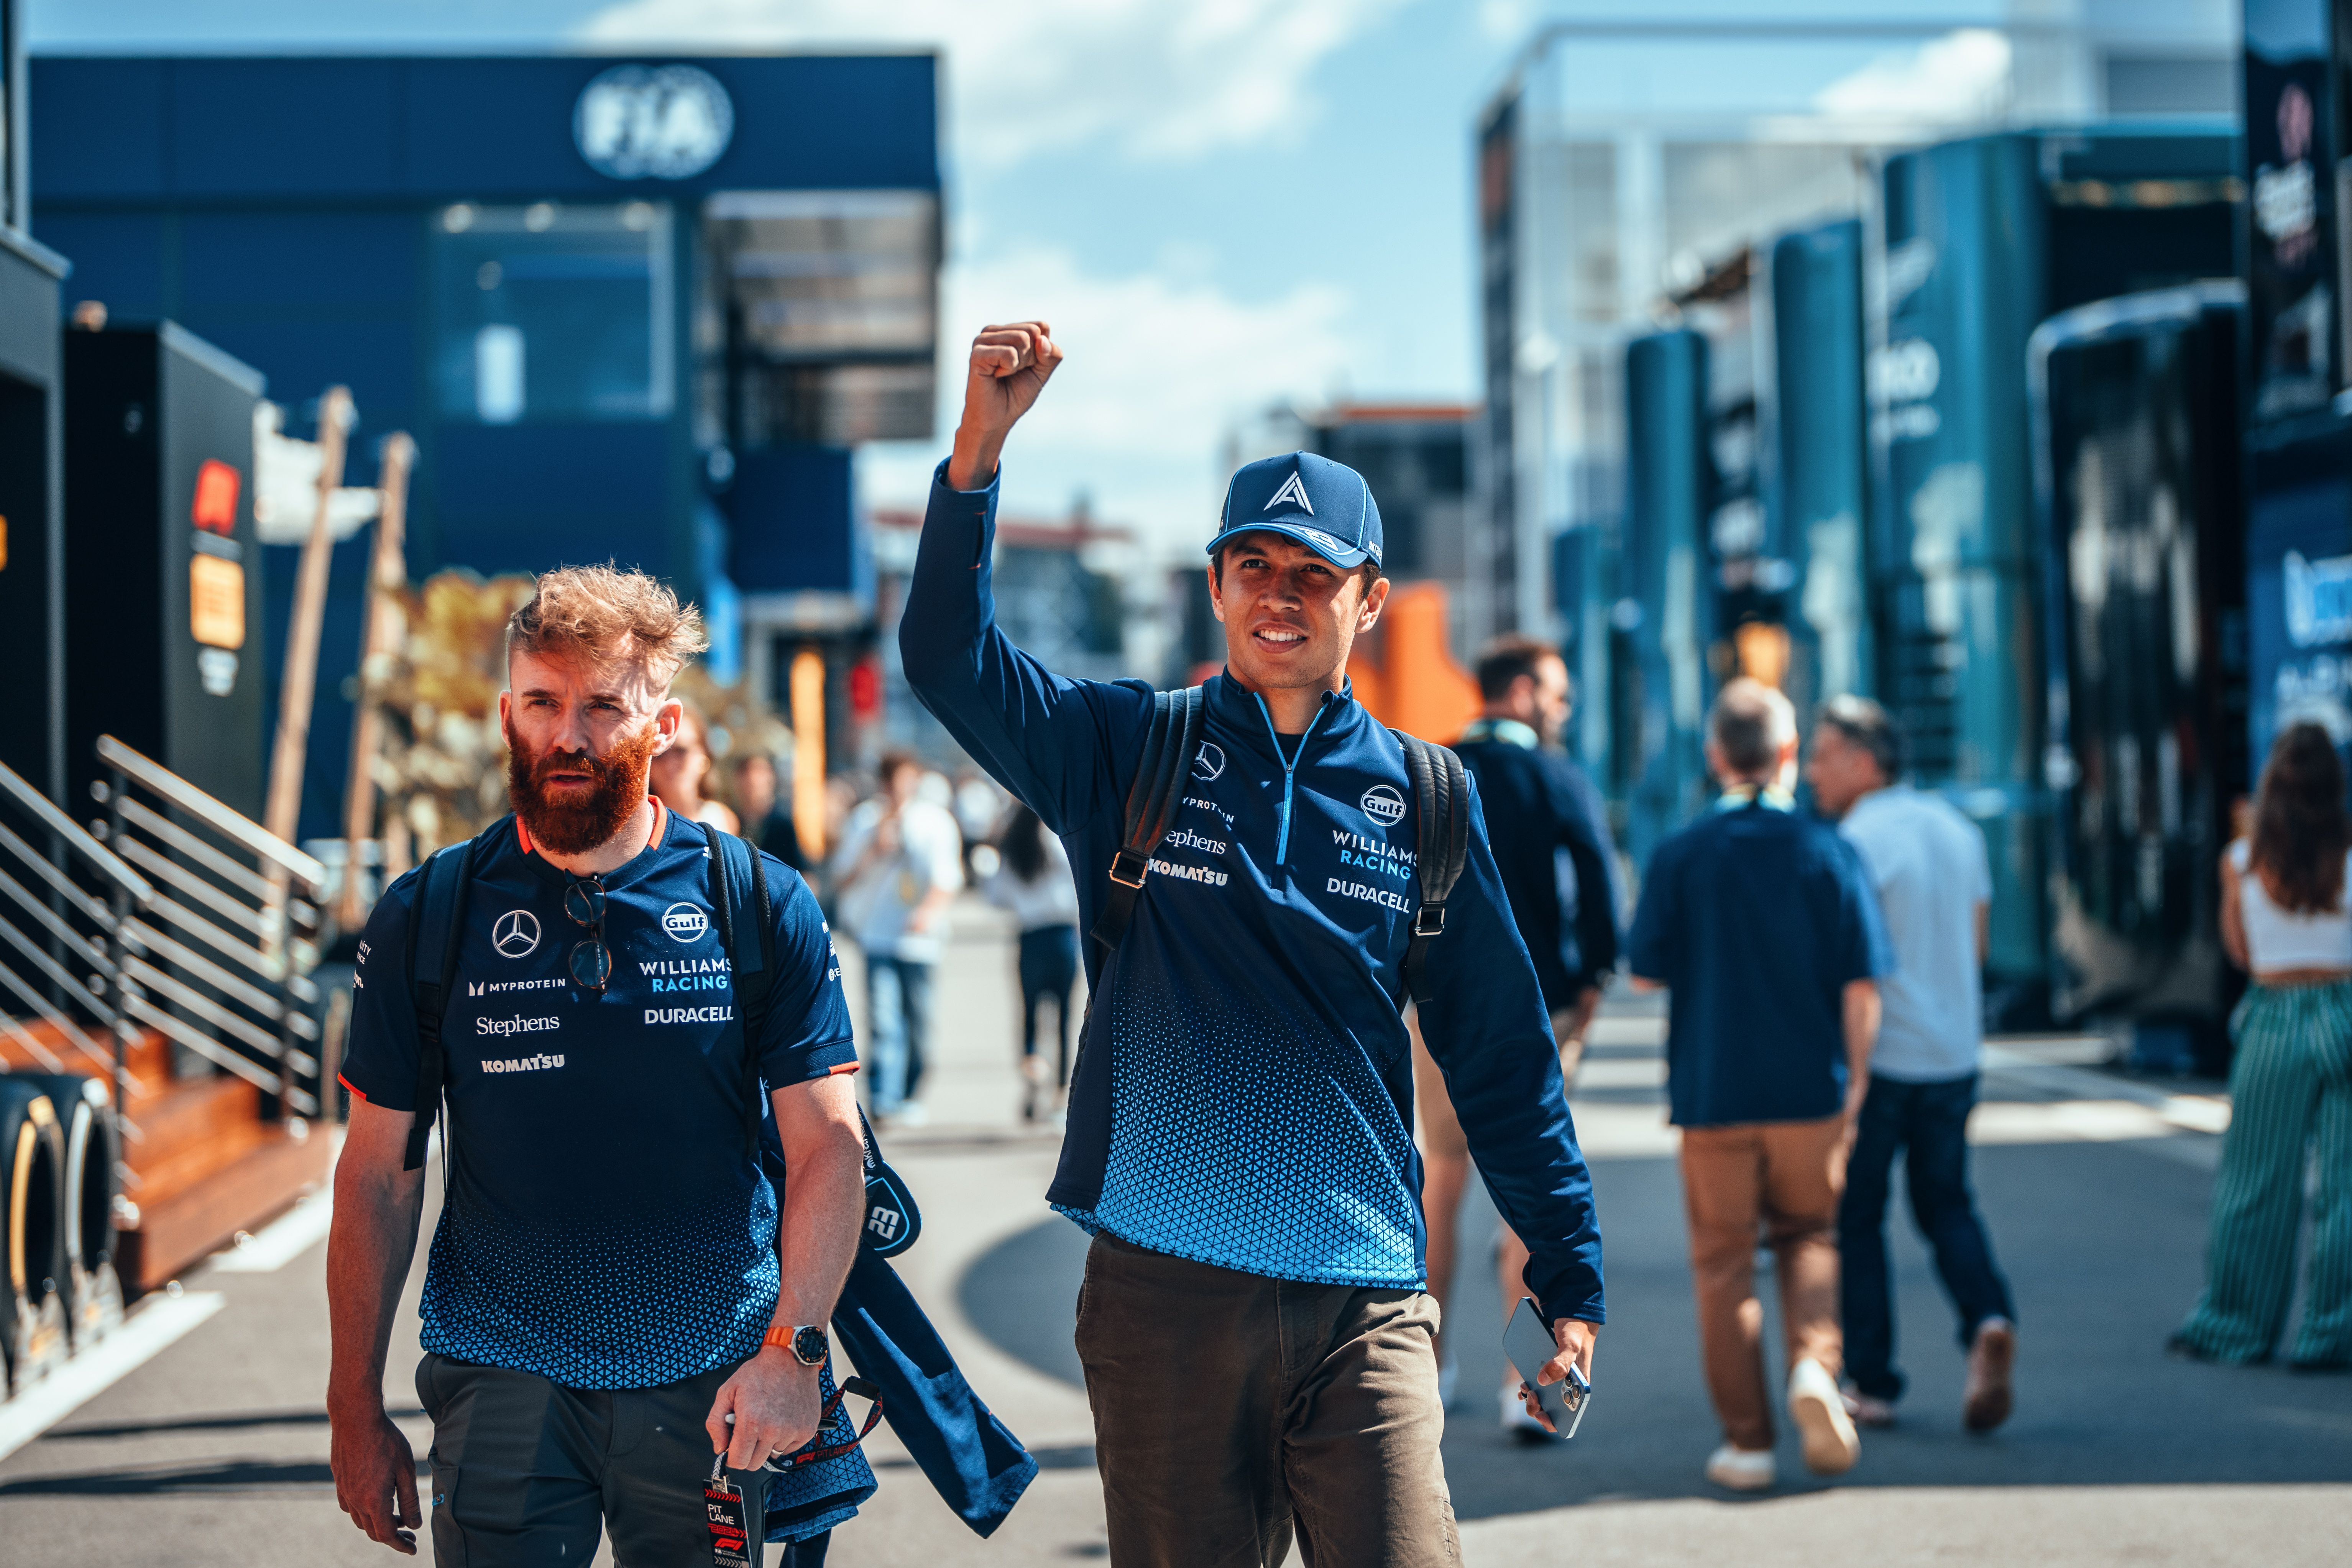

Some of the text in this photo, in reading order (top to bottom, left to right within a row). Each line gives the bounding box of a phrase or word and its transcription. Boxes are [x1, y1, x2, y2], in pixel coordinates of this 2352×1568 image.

[1183, 797, 1234, 823] YPROTEIN
[1363, 797, 1403, 816] Gulf
[1165, 829, 1226, 854] ephens
[1148, 858, 1228, 886] KOMATSU
[1340, 849, 1411, 880] RACING
[1327, 878, 1409, 914] DURACELL
[665, 917, 705, 928] Gulf
[489, 979, 565, 992] MYPROTEIN
[652, 975, 728, 992] RACING
[644, 1006, 734, 1024] DURACELL
[476, 1014, 560, 1036] Stephens
[481, 1053, 565, 1073] KOMATSU
[868, 1206, 900, 1240] 23
[817, 1450, 829, 1459] PIT
[829, 1445, 847, 1456] LANE
[708, 1504, 722, 1514] PIT
[710, 1512, 734, 1525] LANE
